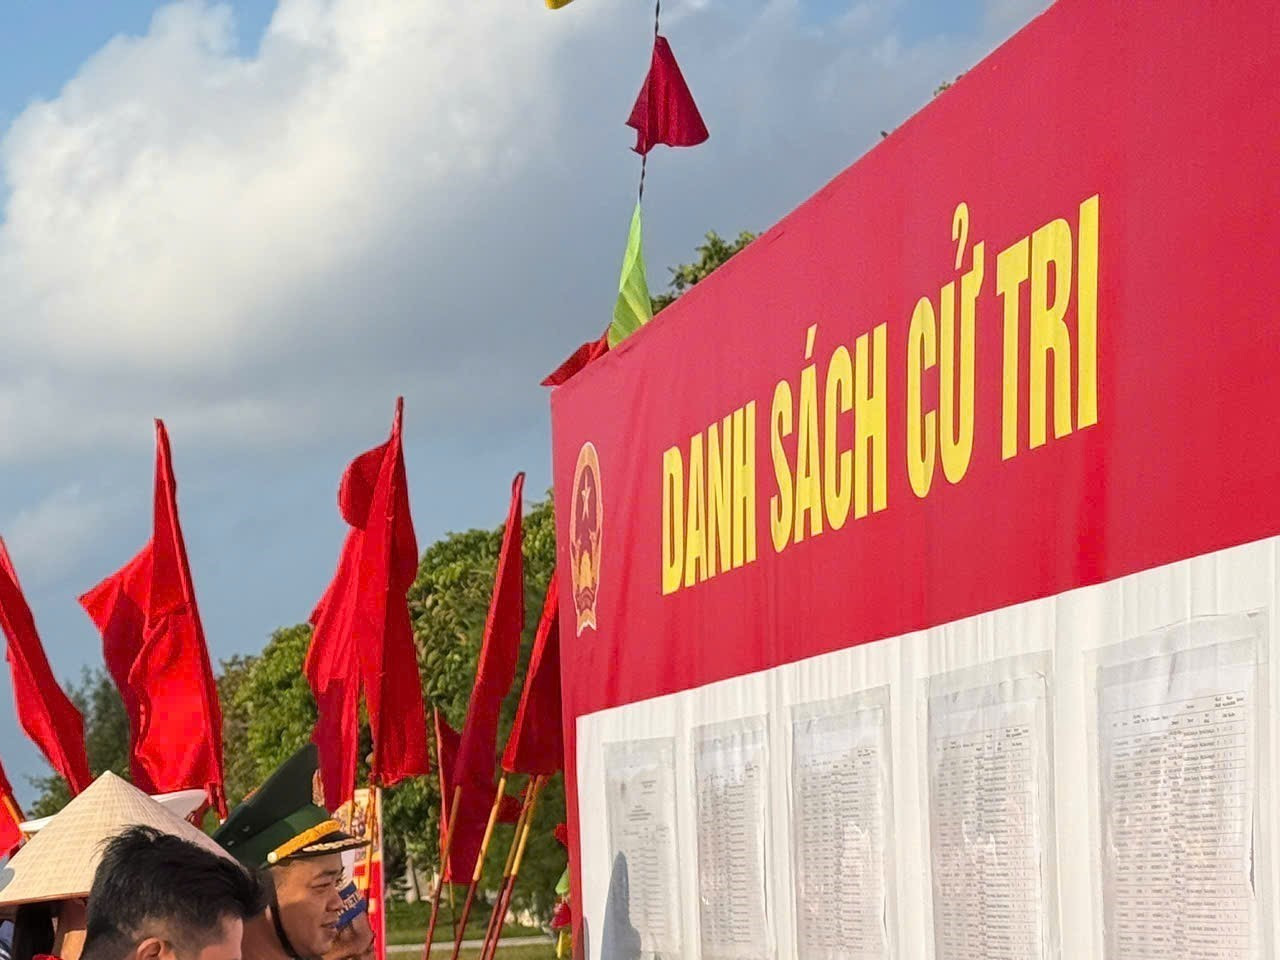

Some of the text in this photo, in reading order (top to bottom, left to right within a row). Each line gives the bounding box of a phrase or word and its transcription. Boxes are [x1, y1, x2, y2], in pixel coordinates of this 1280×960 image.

[661, 192, 1100, 596] DANH SÁCH CỬ TRI
